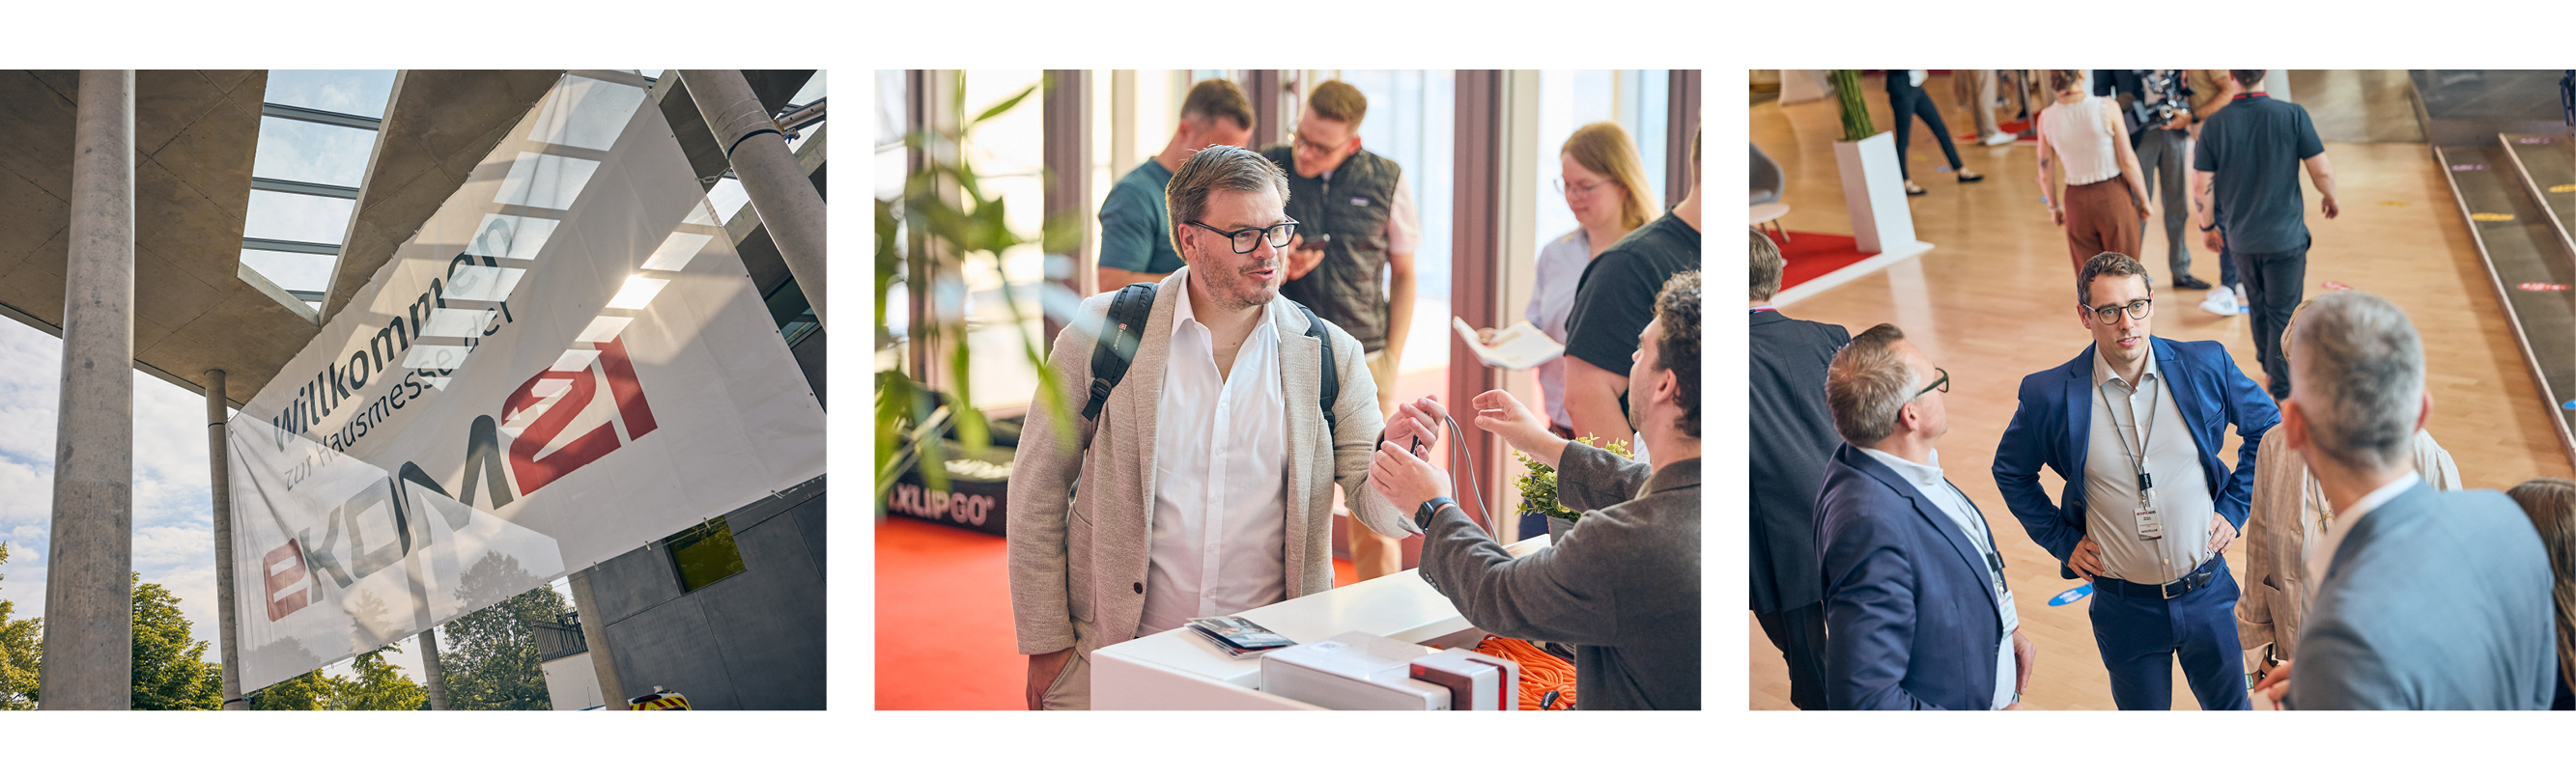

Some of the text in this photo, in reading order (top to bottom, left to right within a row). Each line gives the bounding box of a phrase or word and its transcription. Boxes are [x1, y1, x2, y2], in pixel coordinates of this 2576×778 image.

[273, 218, 513, 453] Willkommen
[284, 292, 513, 491] zur Hausmesse der
